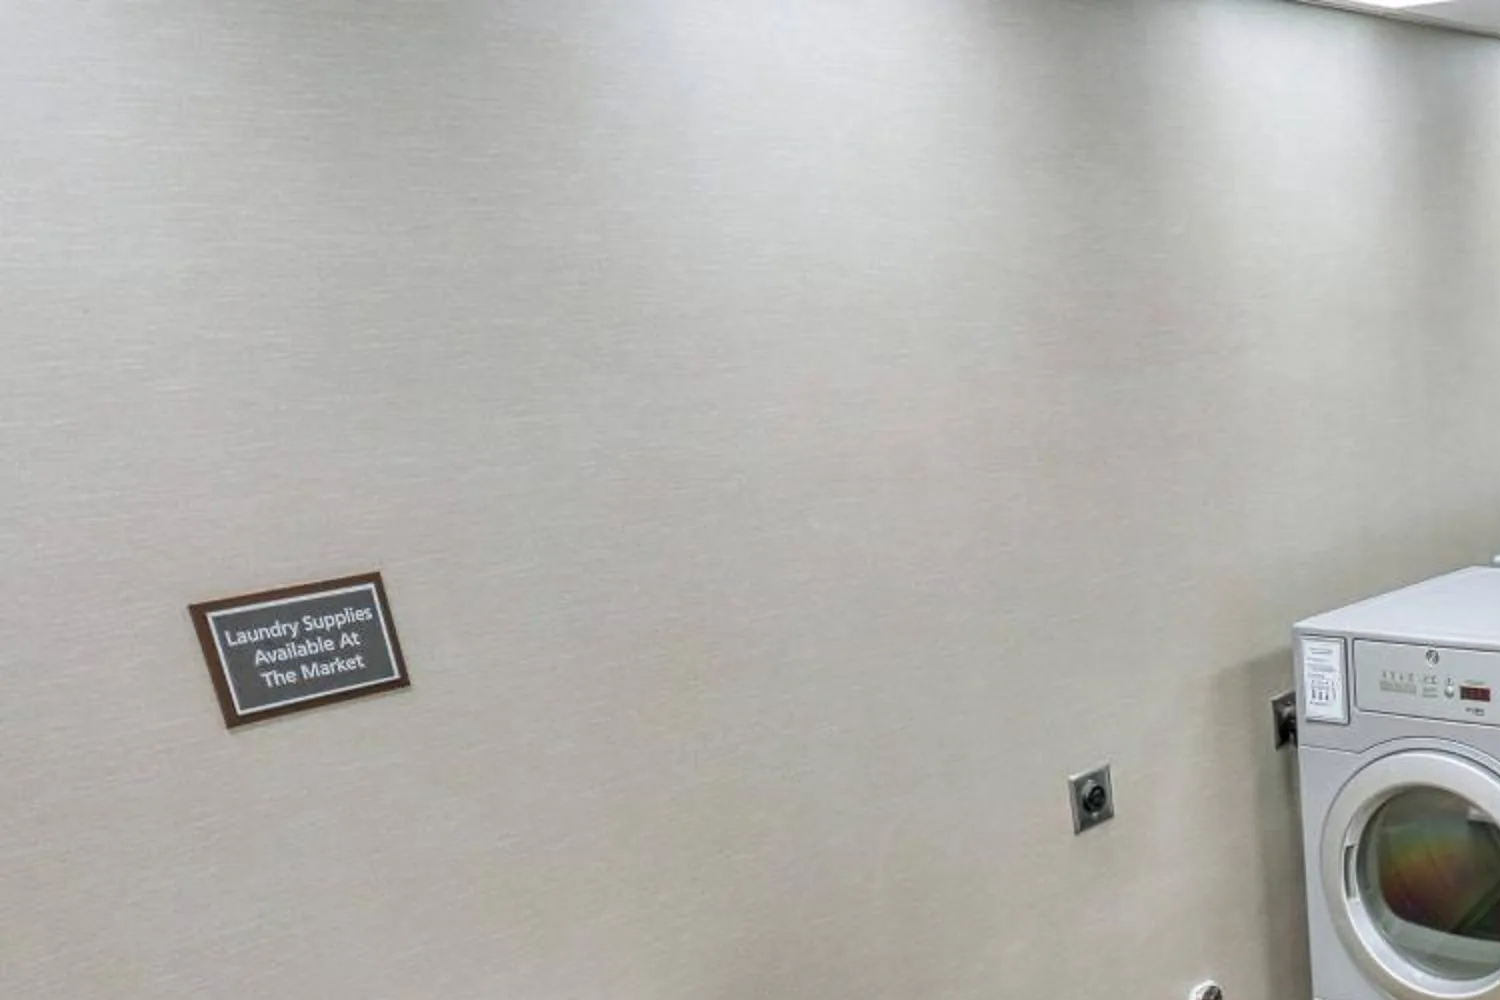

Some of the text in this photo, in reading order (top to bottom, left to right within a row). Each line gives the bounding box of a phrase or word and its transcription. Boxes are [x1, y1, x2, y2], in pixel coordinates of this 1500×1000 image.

[224, 606, 374, 647] Laundry Supplies
[254, 632, 362, 667] Available At
[260, 653, 367, 689] The Market
